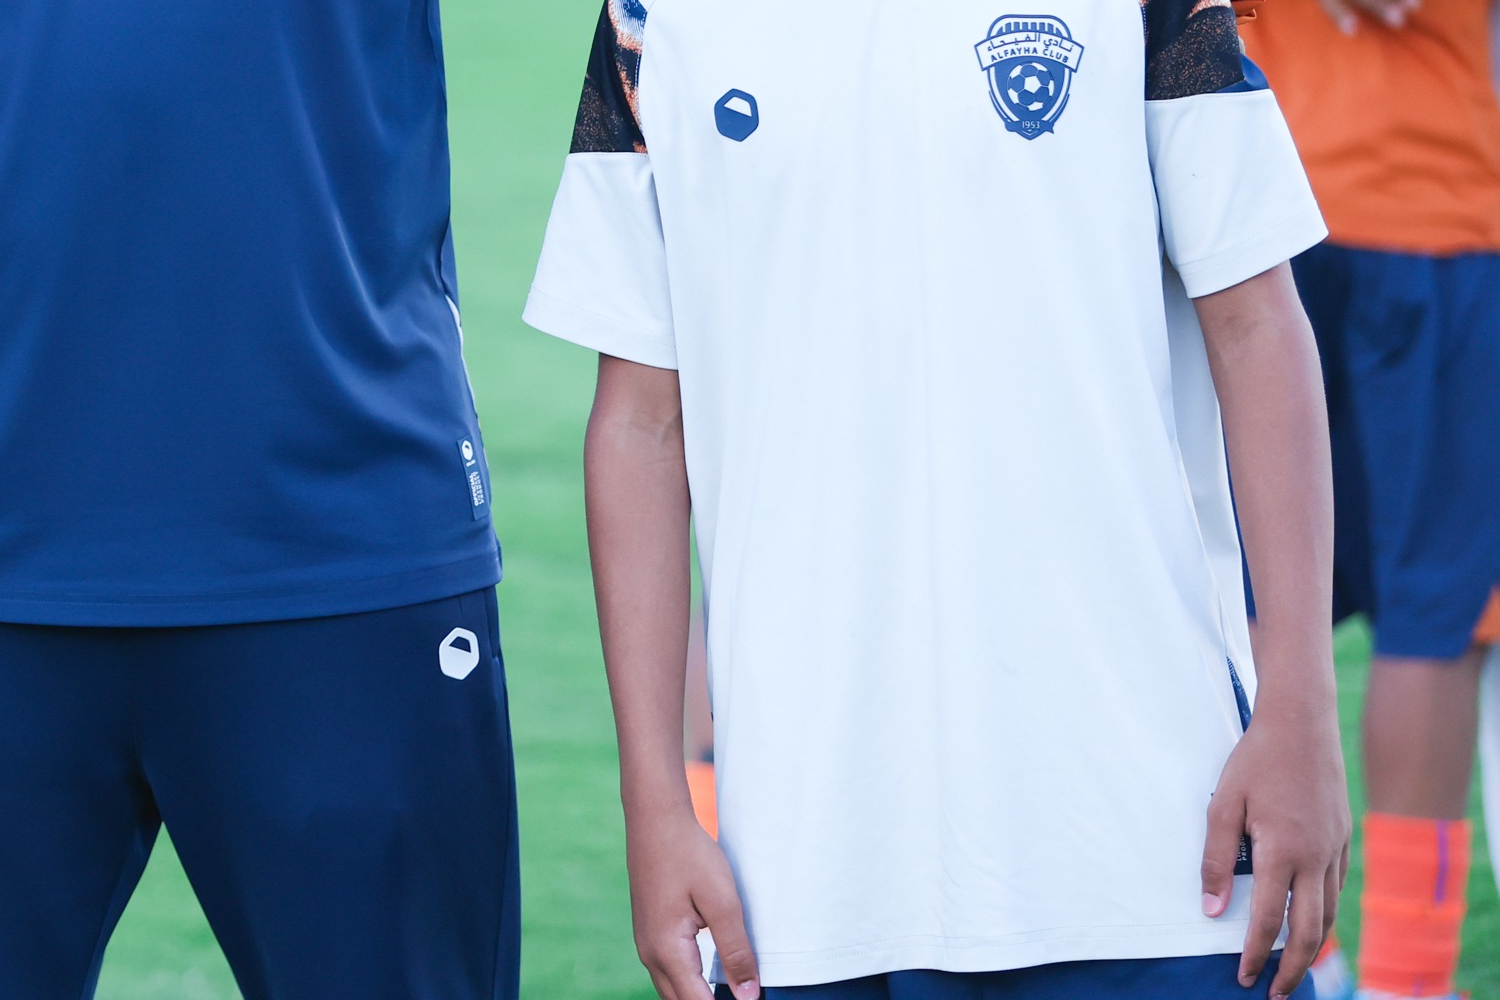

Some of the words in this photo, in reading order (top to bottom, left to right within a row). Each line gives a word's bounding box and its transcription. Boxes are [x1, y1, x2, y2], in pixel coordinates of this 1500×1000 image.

[987, 33, 1041, 52] الفيحاء
[1043, 37, 1073, 53] نادي
[991, 47, 1039, 62] ALFAYHA
[1043, 48, 1069, 63] CLUB
[1022, 121, 1040, 129] 1953
